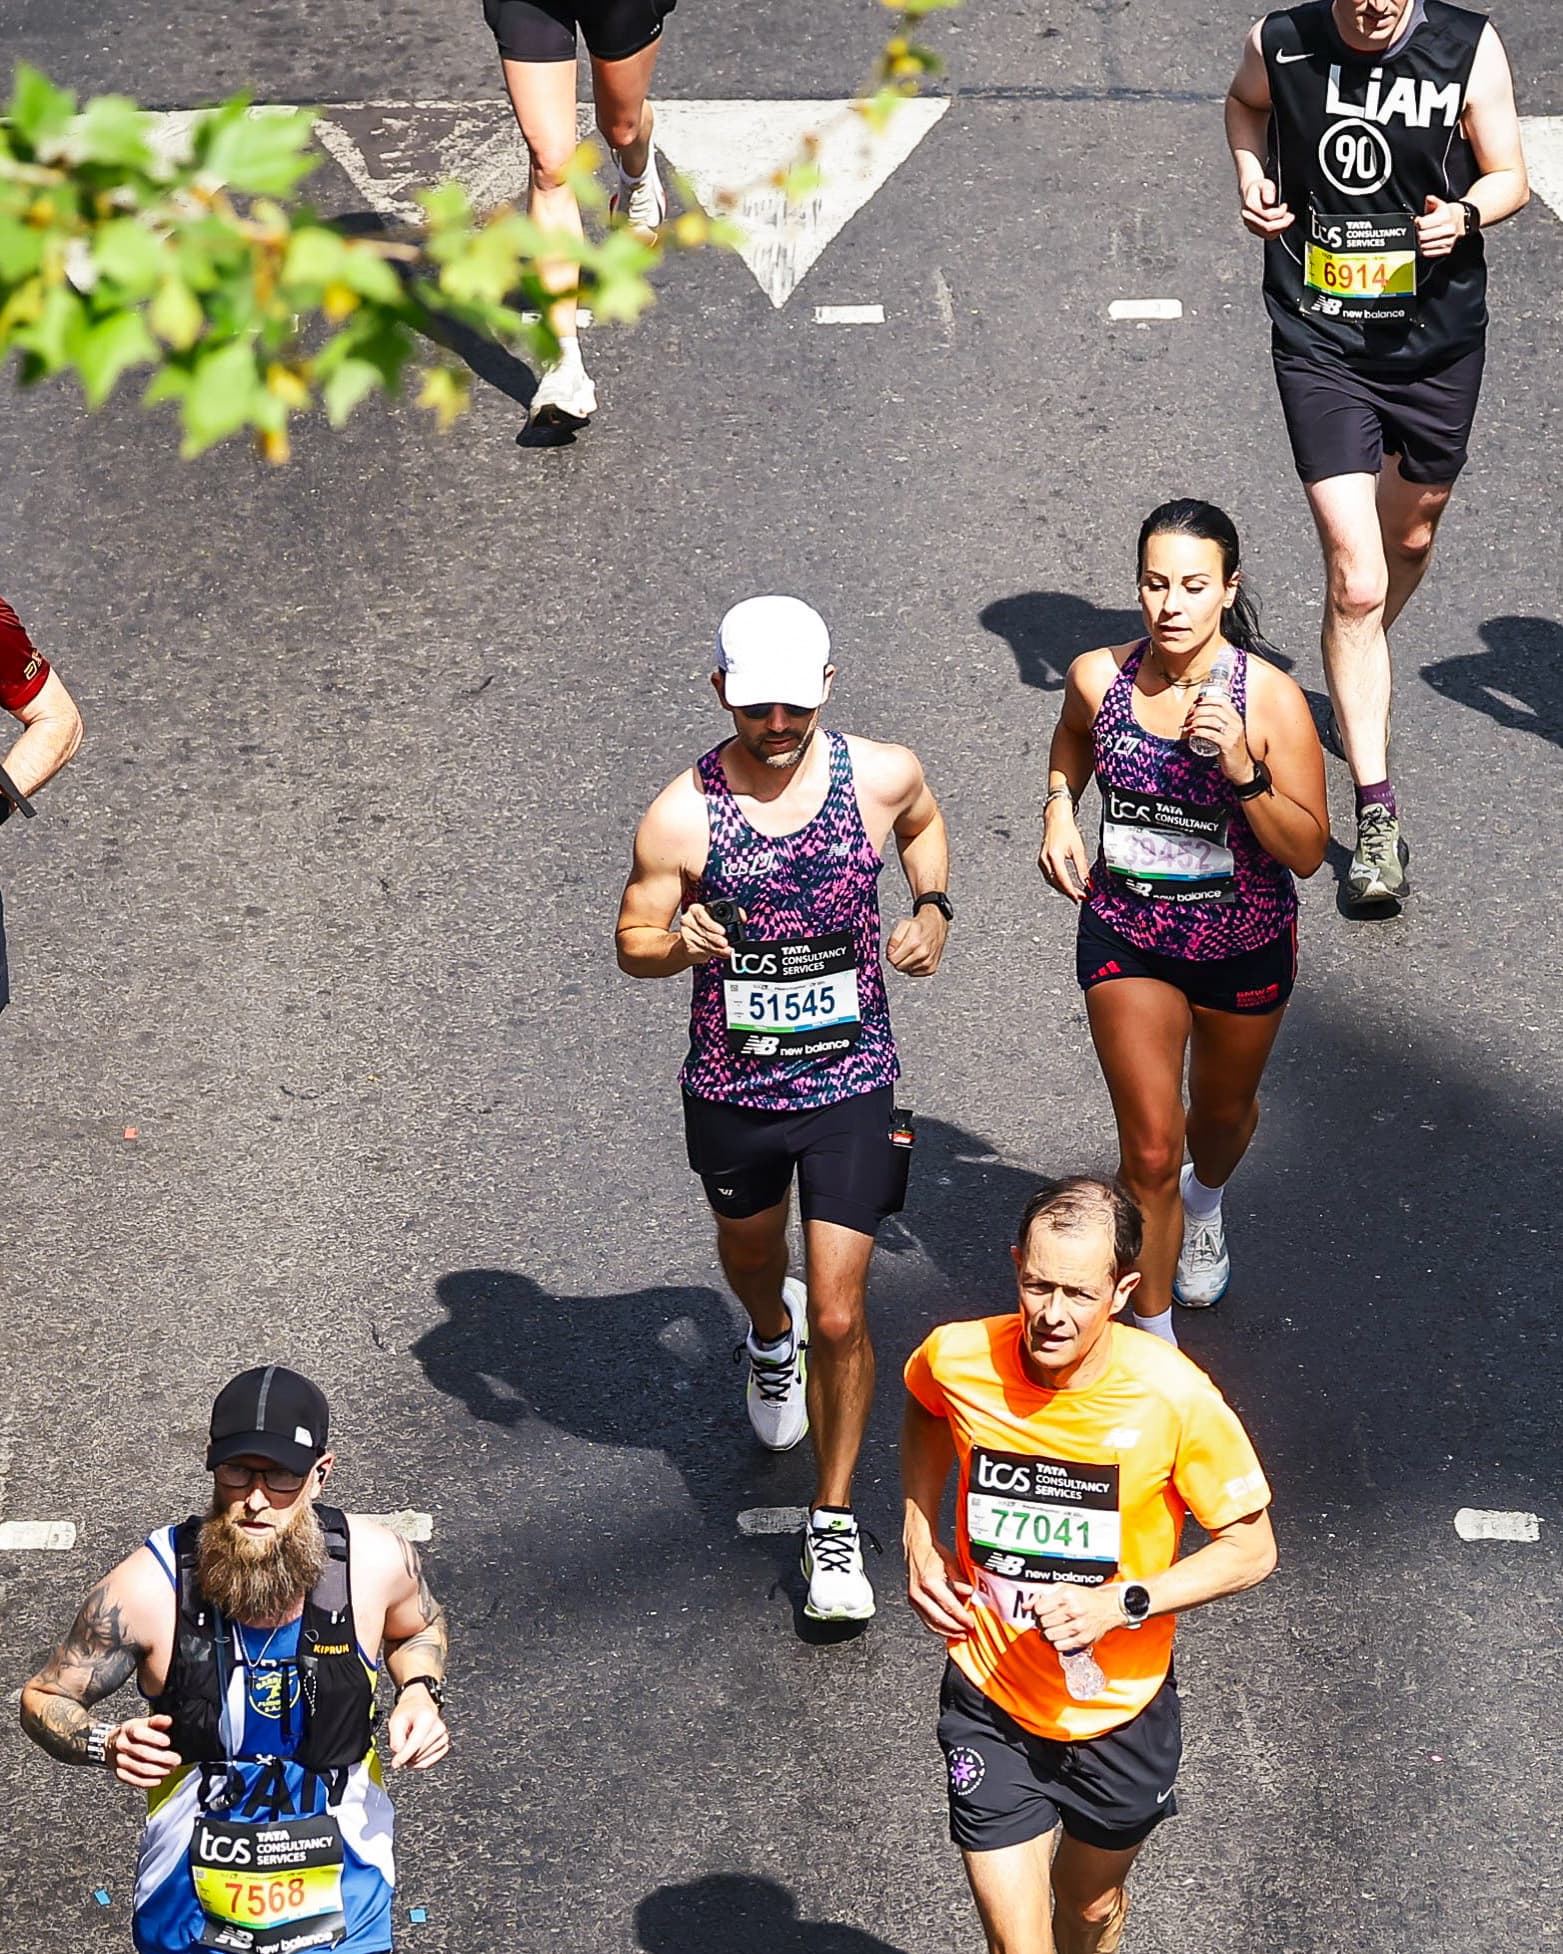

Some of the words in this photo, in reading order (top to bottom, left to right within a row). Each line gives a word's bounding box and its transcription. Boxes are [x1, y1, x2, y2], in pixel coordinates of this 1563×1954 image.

[1335, 134, 1377, 179] 90
[1312, 214, 1343, 248] tcs
[1345, 221, 1373, 230] TATA
[1346, 228, 1407, 239] CONSULTANCY
[1346, 238, 1386, 248] SERVICES
[1323, 261, 1389, 289] 6914
[1342, 310, 1363, 319] new
[1363, 309, 1405, 319] balance
[1110, 791, 1150, 822] tcs
[1155, 802, 1183, 816] TATA
[1154, 814, 1219, 832] CONSULTANCY
[1176, 890, 1222, 902] balance
[780, 945, 811, 956] TATA
[781, 946, 847, 966] CONSULTANCY
[730, 948, 777, 975] tcs
[782, 961, 825, 976] SERVICES
[749, 985, 836, 1022] 51545
[779, 1048, 803, 1057] new
[804, 1039, 850, 1055] balance
[978, 1454, 1031, 1493] tcs
[1035, 1463, 1068, 1477] TATA
[1034, 1485, 1083, 1500] SERVICES
[1035, 1474, 1111, 1494] CONSULTANCY
[991, 1508, 1090, 1549] 77041
[1024, 1570, 1051, 1580] new
[1052, 1570, 1104, 1584] balance
[313, 1643, 350, 1655] KIPRUN
[200, 1826, 252, 1865] tcs
[255, 1830, 290, 1843] TATA
[256, 1836, 334, 1854] CONSULTANCY
[257, 1852, 307, 1866] SERVICES
[225, 1877, 306, 1917] 7568
[255, 1942, 280, 1954] new
[280, 1931, 335, 1953] balance
